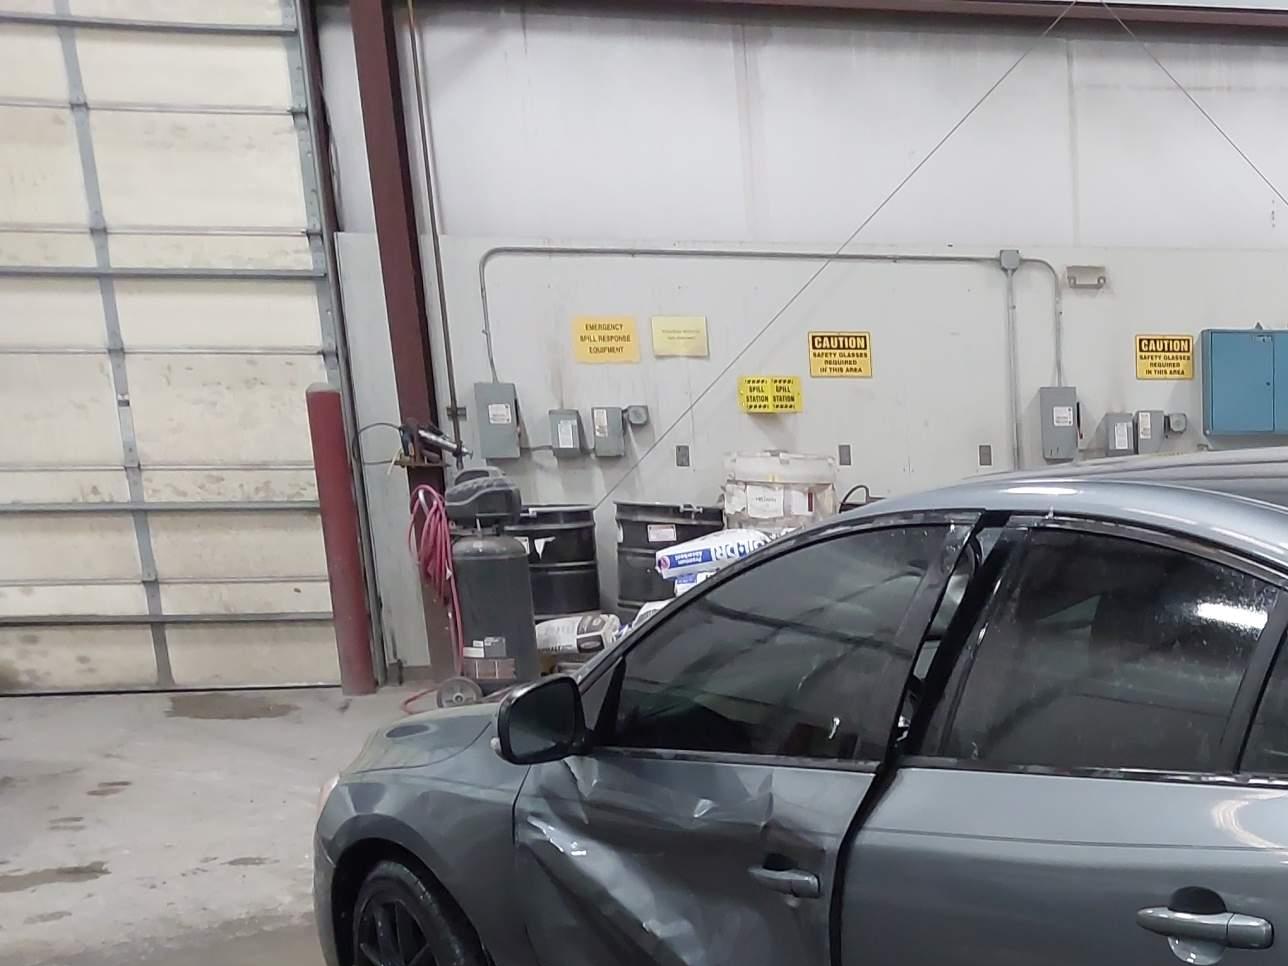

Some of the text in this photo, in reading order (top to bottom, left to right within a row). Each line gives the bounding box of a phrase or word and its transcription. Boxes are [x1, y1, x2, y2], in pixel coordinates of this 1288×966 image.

[584, 323, 624, 331] EMERGENCY
[814, 336, 866, 349] CAUTION
[1141, 340, 1189, 352] CAUTION
[749, 385, 765, 393] SPILL
[775, 385, 791, 393] SPILL
